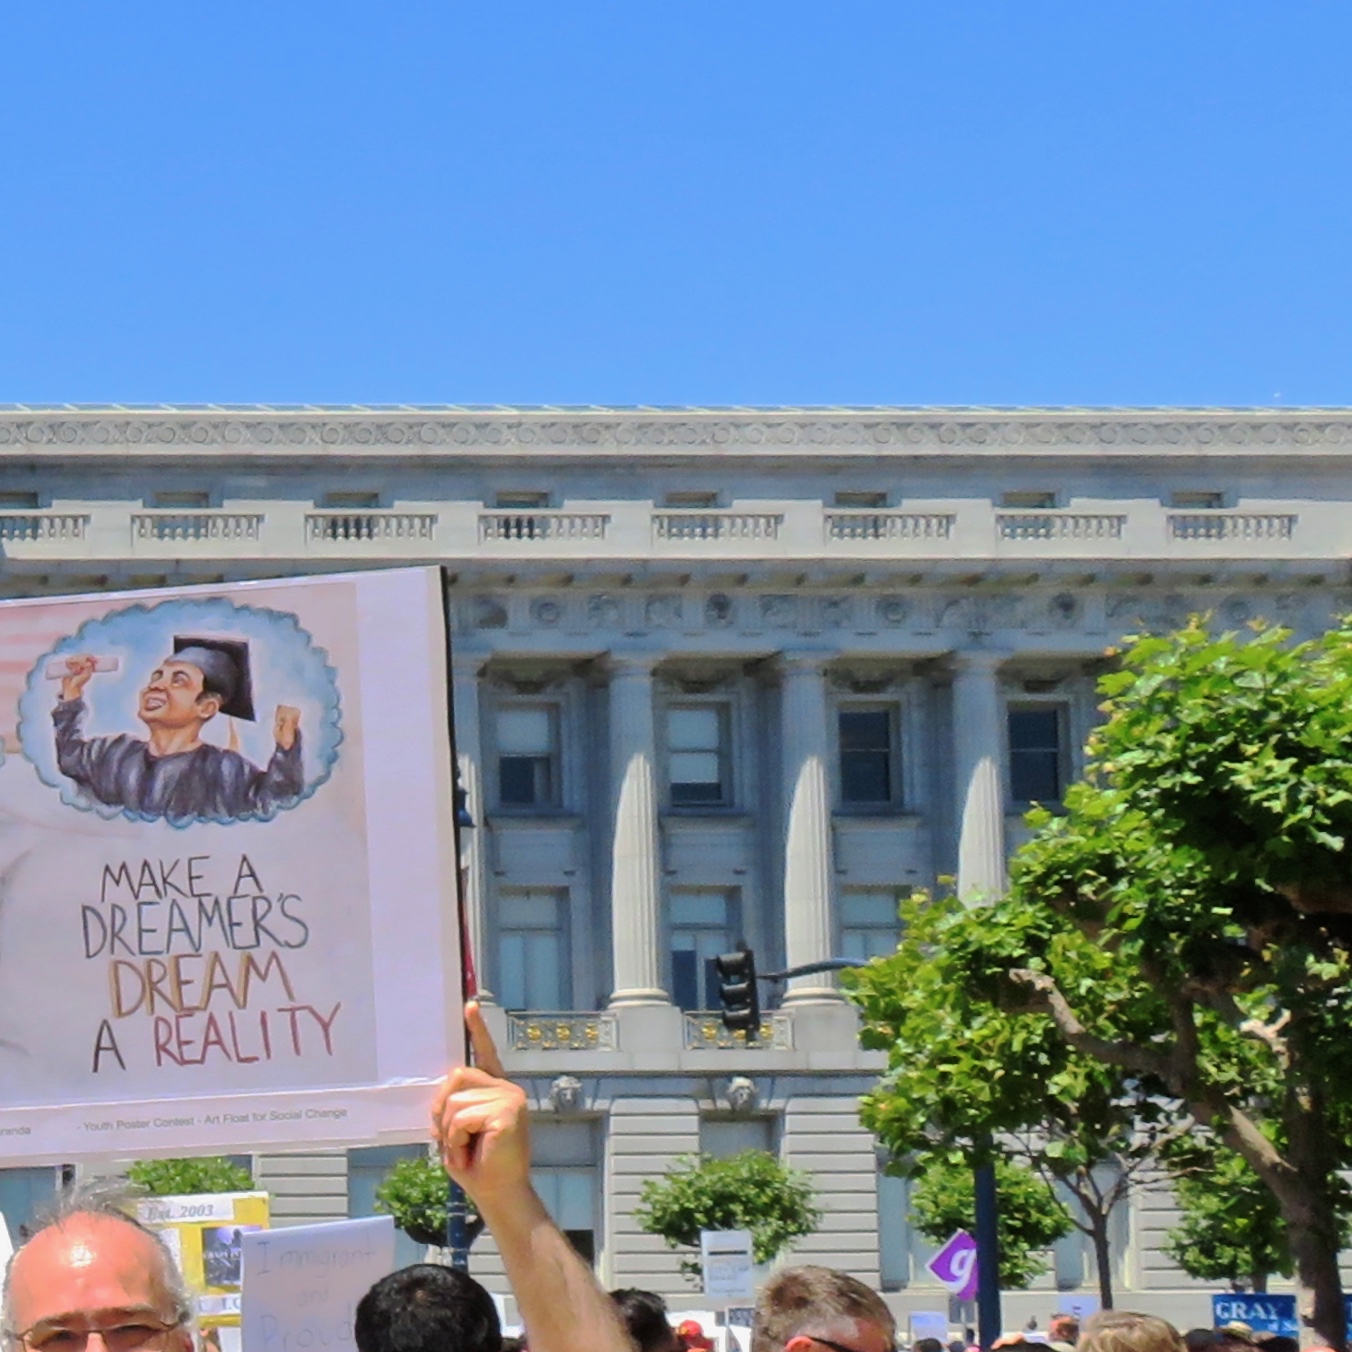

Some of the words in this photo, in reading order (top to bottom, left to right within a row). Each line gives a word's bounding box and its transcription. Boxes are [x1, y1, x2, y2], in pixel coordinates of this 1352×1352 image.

[101, 856, 212, 902] MAKE
[233, 854, 264, 895] A
[82, 893, 309, 959] DREAMER'S
[109, 950, 296, 1019] DREAM
[92, 1019, 126, 1073] A
[153, 1002, 341, 1067] REALITY
[83, 1121, 113, 1131] Youth
[116, 1118, 150, 1130] Poster
[153, 1116, 194, 1128] Contest
[204, 1114, 220, 1125] Art
[223, 1112, 249, 1123] Float
[252, 1111, 266, 1121] for
[269, 1110, 302, 1121] Social
[304, 1108, 348, 1120] Change
[179, 1204, 215, 1218] 2003
